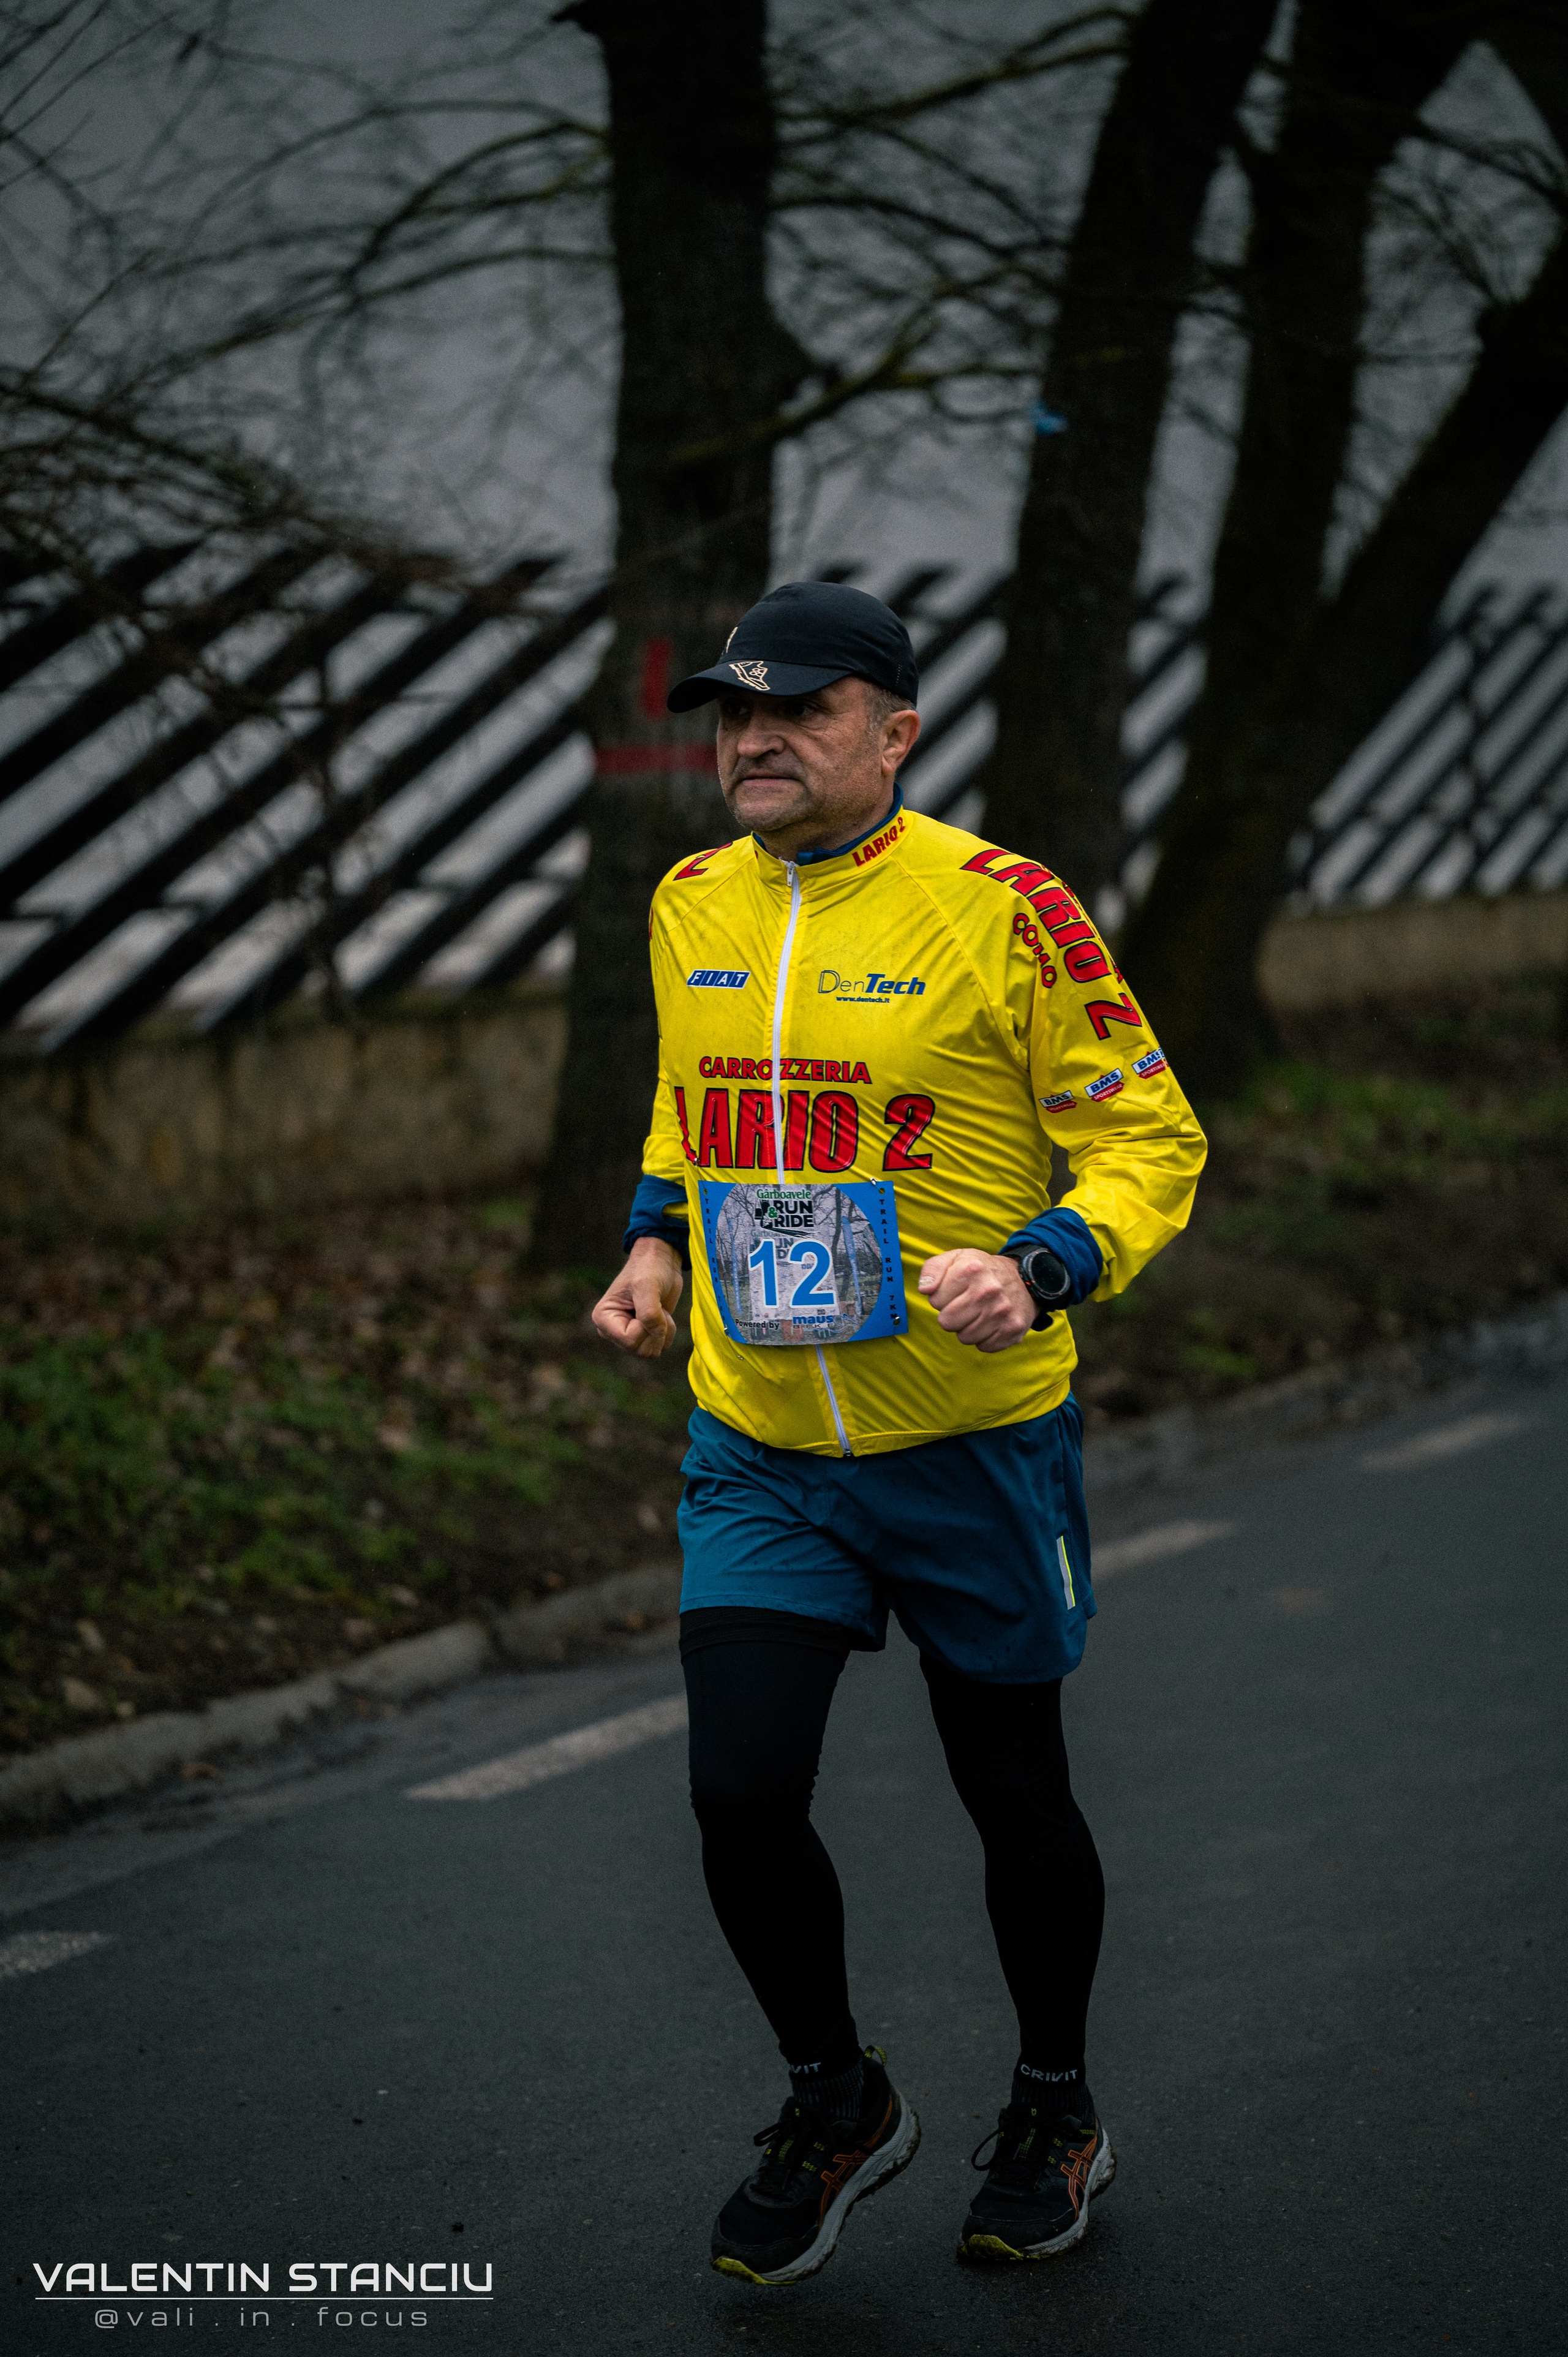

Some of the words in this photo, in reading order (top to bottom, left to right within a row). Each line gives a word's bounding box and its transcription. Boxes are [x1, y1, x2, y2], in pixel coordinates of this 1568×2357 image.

[851, 825, 897, 867] LARIO
[897, 816, 905, 832] 2
[960, 848, 1112, 983] LARIO
[1084, 991, 1142, 1041] 2
[690, 971, 745, 986] FIAT
[818, 970, 926, 995] DenTech
[836, 995, 890, 1004] www.dentech.it
[699, 1056, 872, 1084] CARROZZERIA
[1091, 1072, 1120, 1093] BMS
[1043, 1094, 1070, 1106] BMS
[883, 1093, 935, 1172] 2
[756, 1189, 812, 1199] Gârboavele
[773, 1200, 813, 1214] RUN
[774, 1215, 815, 1228] RIDE
[879, 1199, 889, 1244] TRAIL
[748, 1239, 835, 1308] 12
[885, 1257, 894, 1283] RUN
[889, 1295, 898, 1319] 7KM
[735, 1319, 766, 1328] Powered
[769, 1321, 780, 1330] by
[792, 1314, 834, 1324] maus
[1020, 2064, 1077, 2081] CRIVIT
